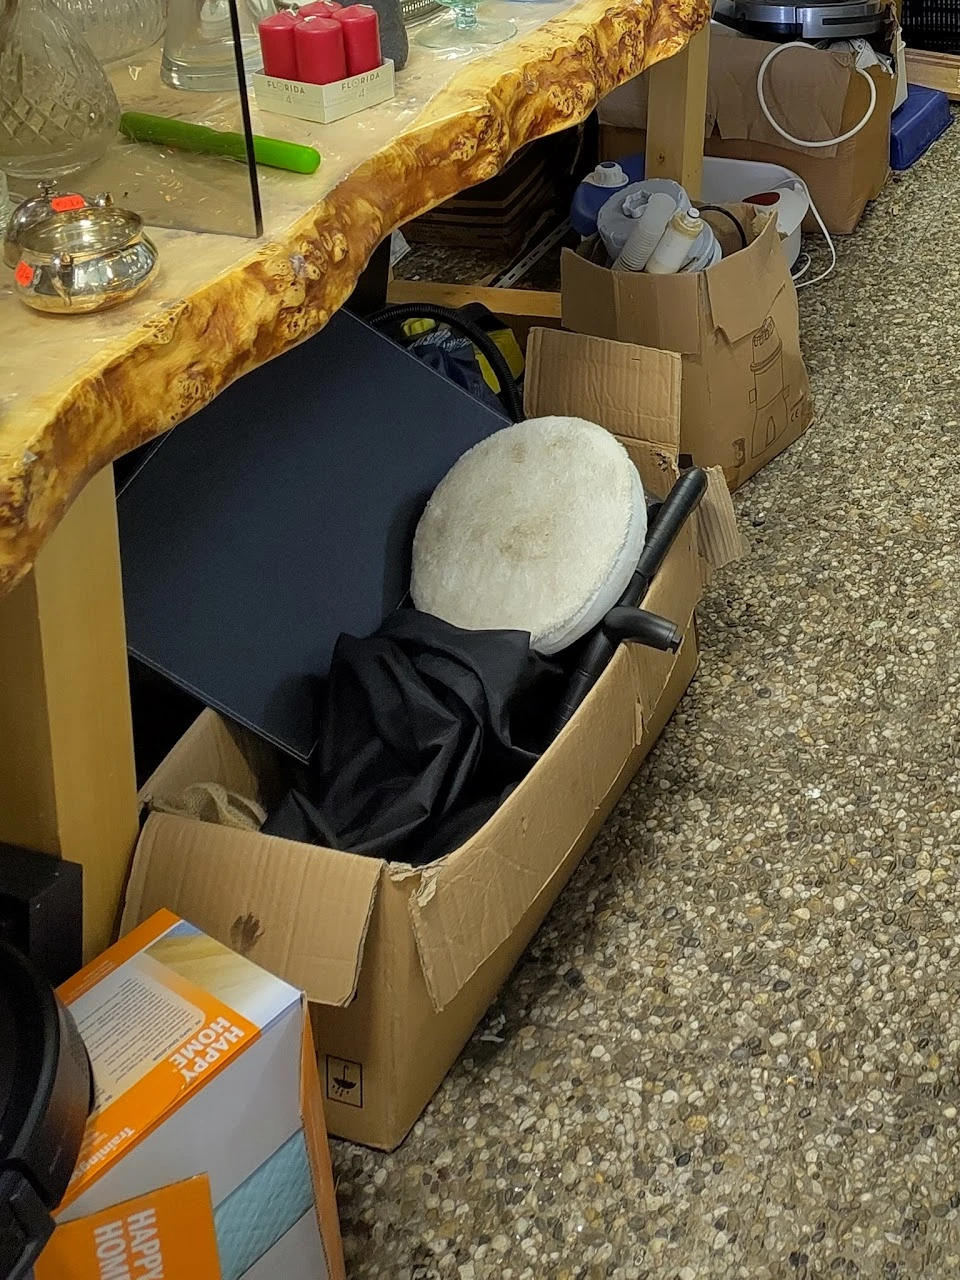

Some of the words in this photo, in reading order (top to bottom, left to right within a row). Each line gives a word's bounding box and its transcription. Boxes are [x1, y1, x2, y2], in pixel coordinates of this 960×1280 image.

[267, 80, 306, 95] FLORIDA
[341, 72, 381, 91] FLORIDA
[168, 1017, 231, 1070] HOME
[180, 1026, 246, 1083] HAPPY
[127, 1207, 165, 1280] HAPPY
